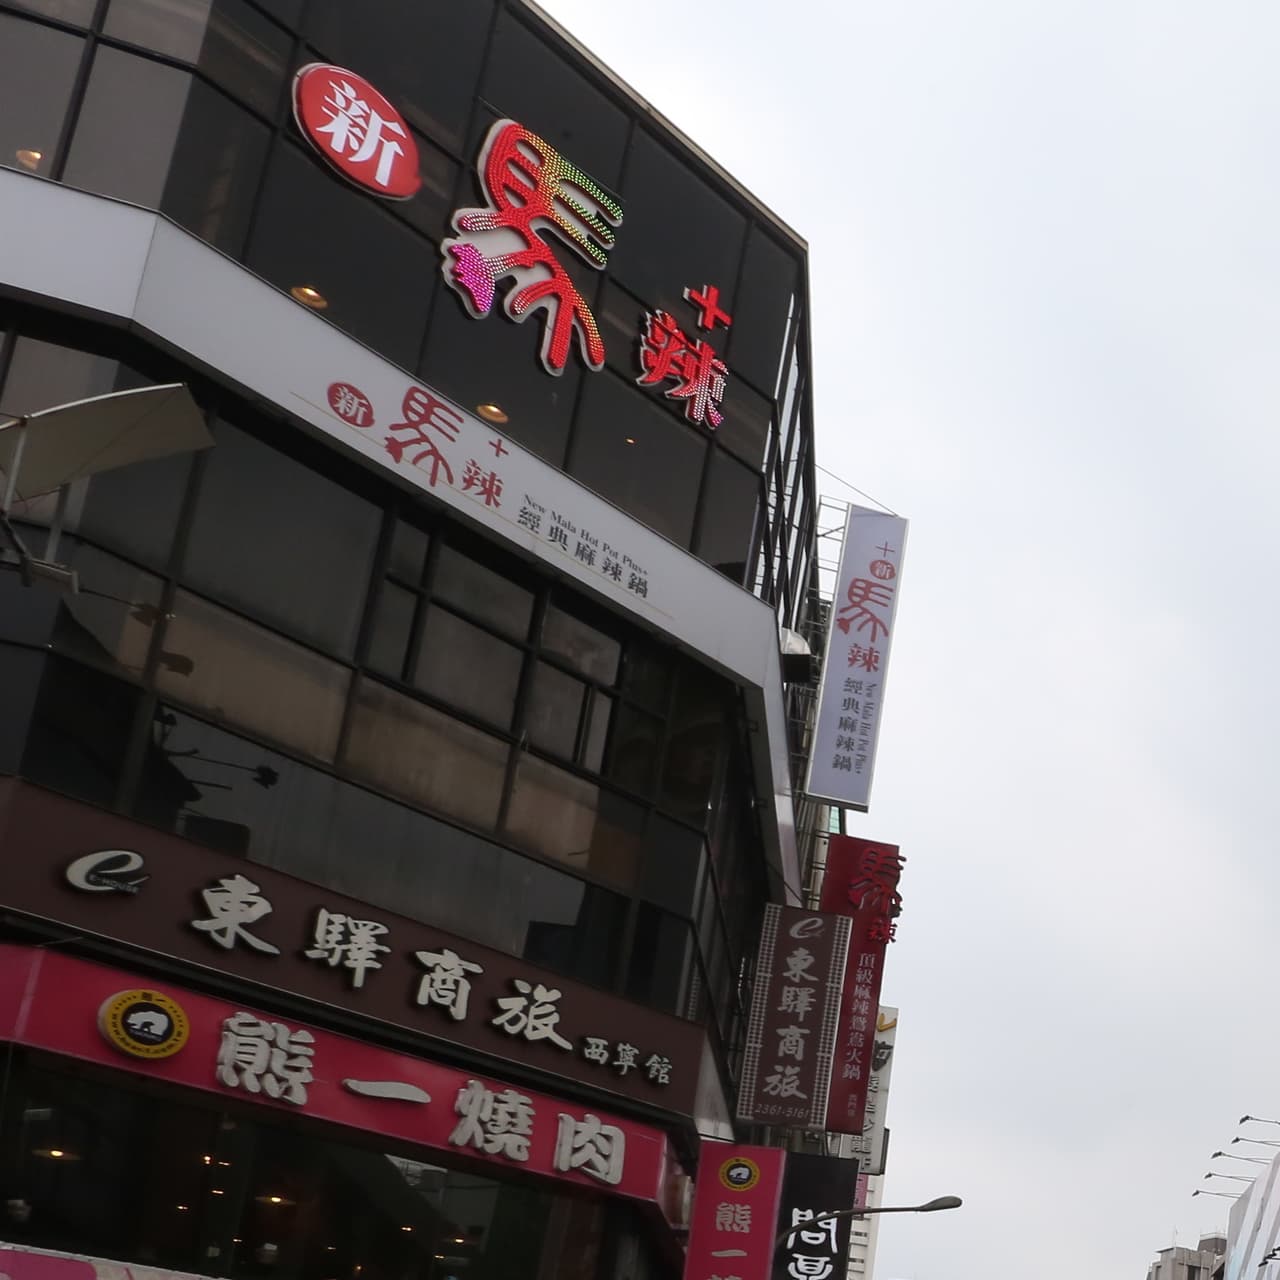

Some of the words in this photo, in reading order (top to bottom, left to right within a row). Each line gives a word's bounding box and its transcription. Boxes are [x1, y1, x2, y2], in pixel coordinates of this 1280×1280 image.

[518, 505, 649, 598] 經典麻辣鍋
[551, 510, 578, 535] Mala
[580, 528, 599, 548] Hot
[602, 541, 619, 560] Pot
[192, 873, 573, 1052] 東驛商旅
[762, 947, 819, 1100] 東驛商旅
[216, 1012, 625, 1186] 熊一燒肉
[583, 1035, 674, 1086] 西寧館
